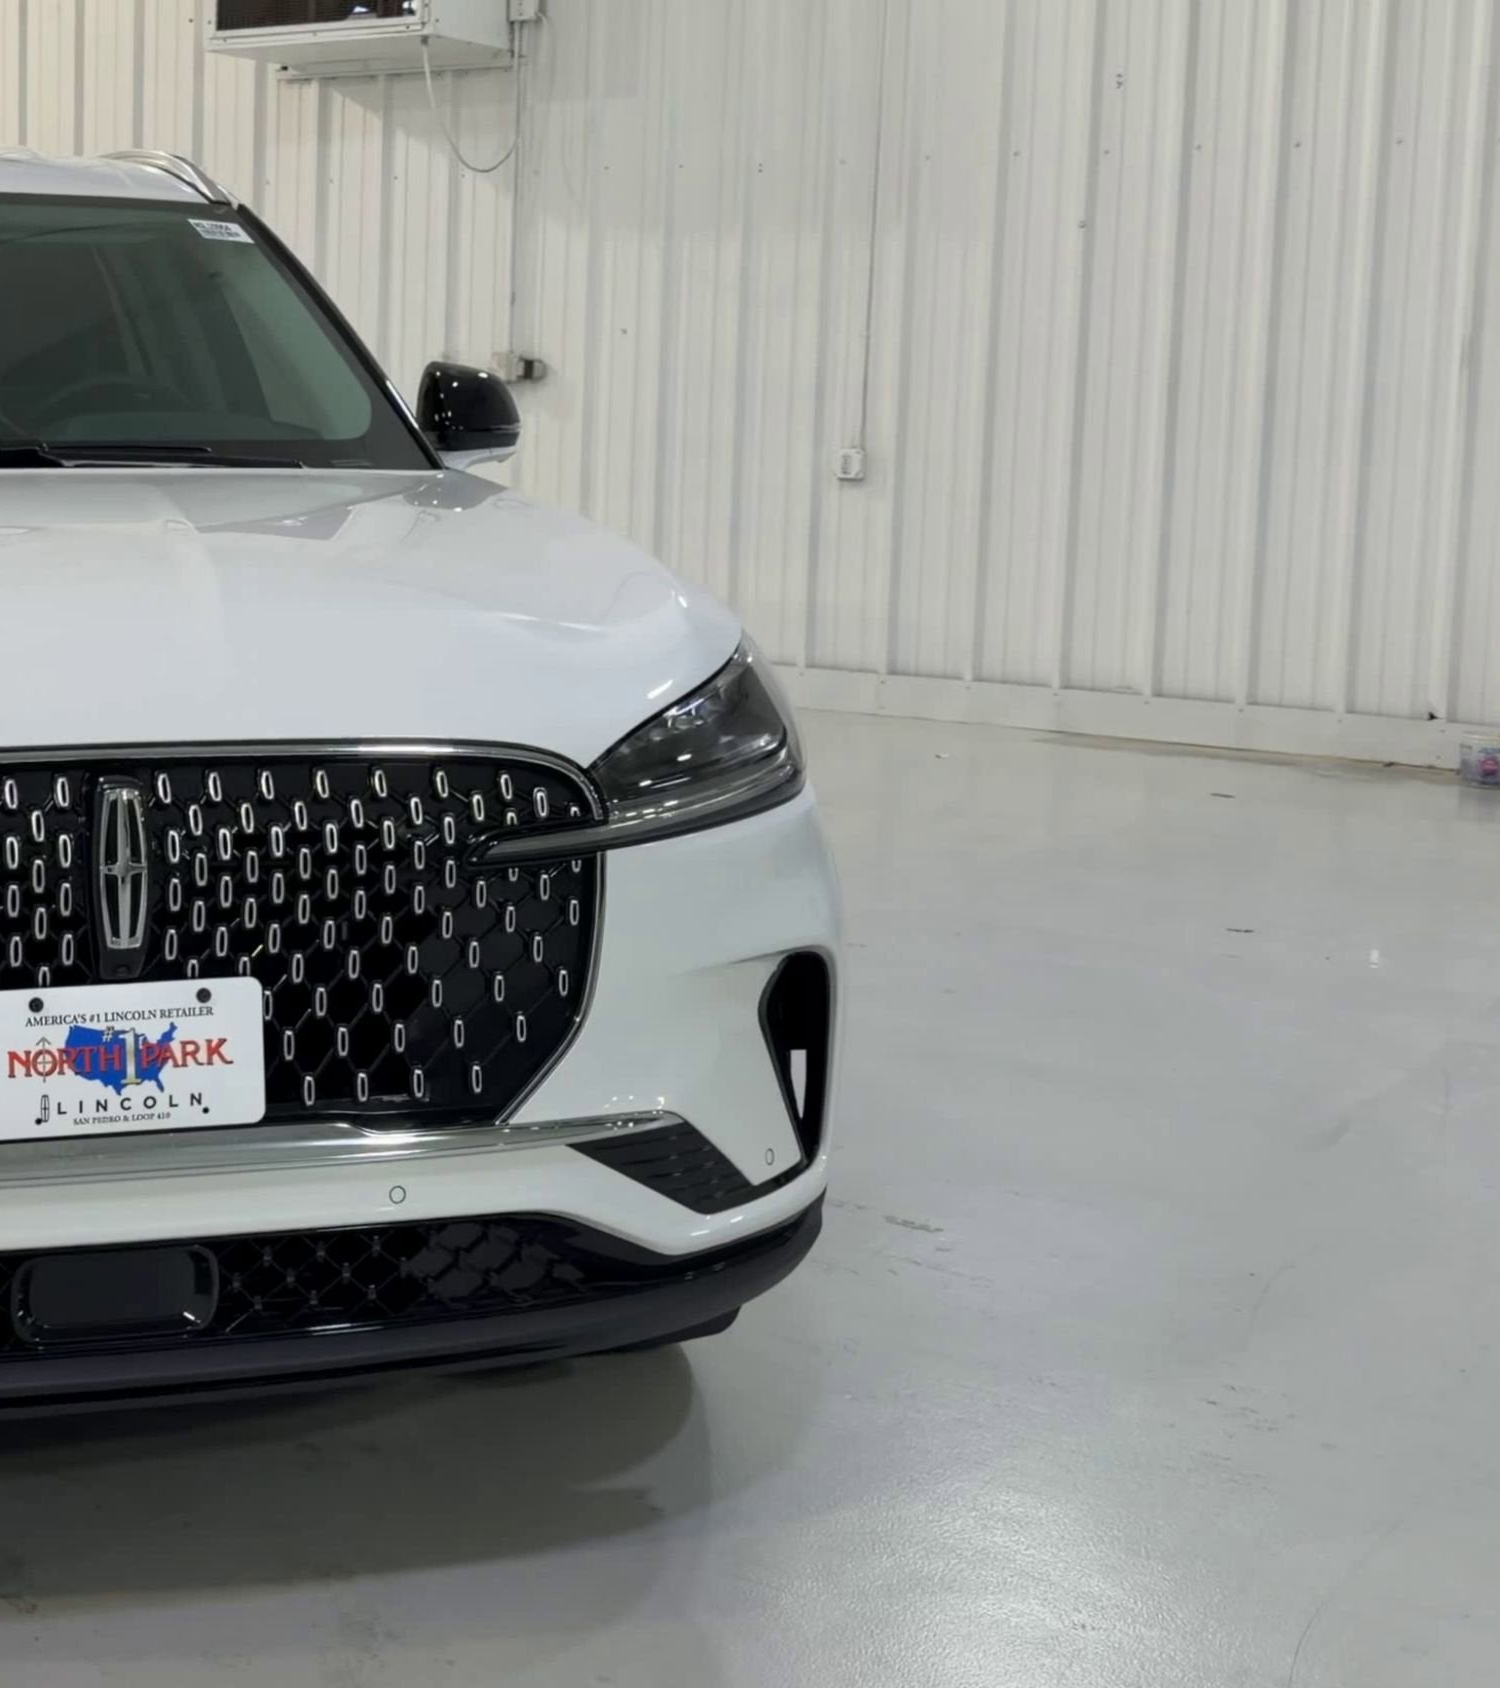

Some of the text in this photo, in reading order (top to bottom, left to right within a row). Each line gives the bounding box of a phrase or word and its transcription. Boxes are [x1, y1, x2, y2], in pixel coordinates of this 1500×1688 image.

[25, 1006, 214, 1027] AMERICA'S #1 LINCOLN RETAILER
[8, 1038, 234, 1078] NORTH PARK
[57, 1093, 202, 1115] LINCOLN
[73, 1117, 90, 1126] SAN
[92, 1115, 121, 1125] PEDRO
[132, 1113, 155, 1121] LOOP
